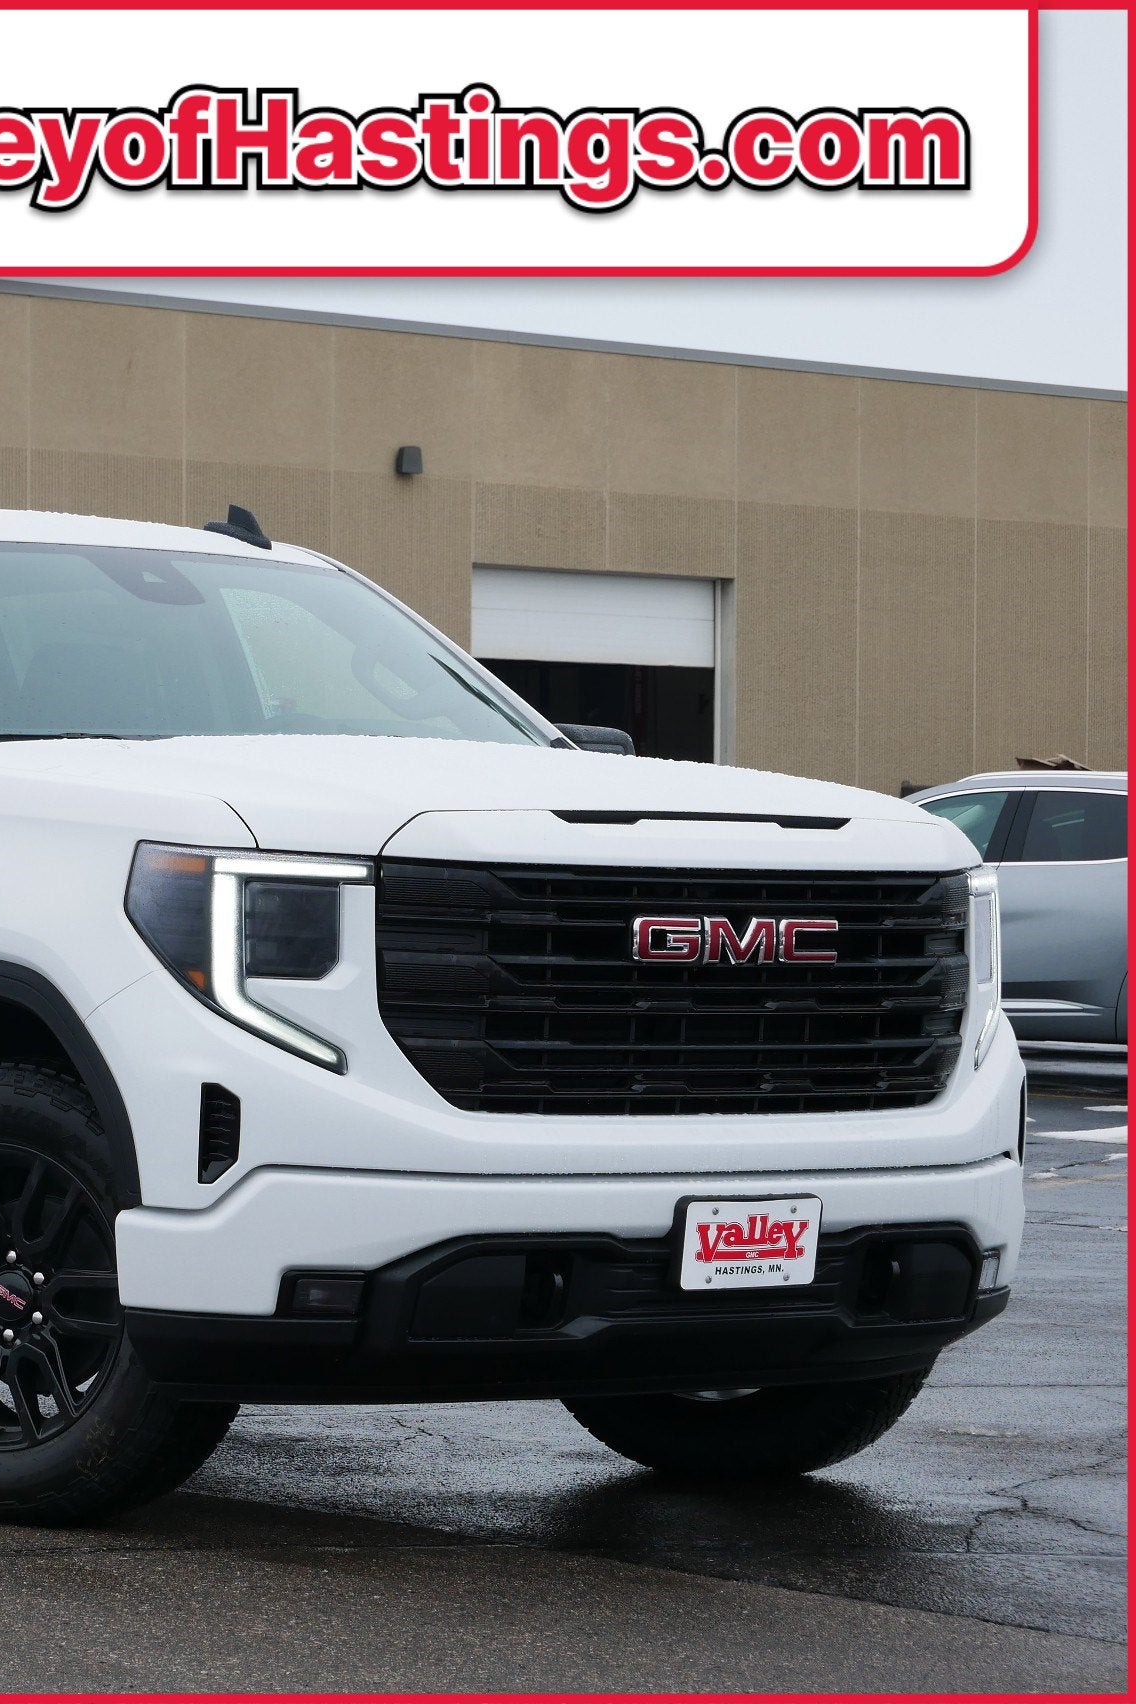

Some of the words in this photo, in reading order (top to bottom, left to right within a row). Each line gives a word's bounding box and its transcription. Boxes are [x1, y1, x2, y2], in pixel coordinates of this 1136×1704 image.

[632, 916, 839, 965] GMC
[715, 1265, 765, 1275] HASTINGS,
[768, 1263, 784, 1273] MN.
